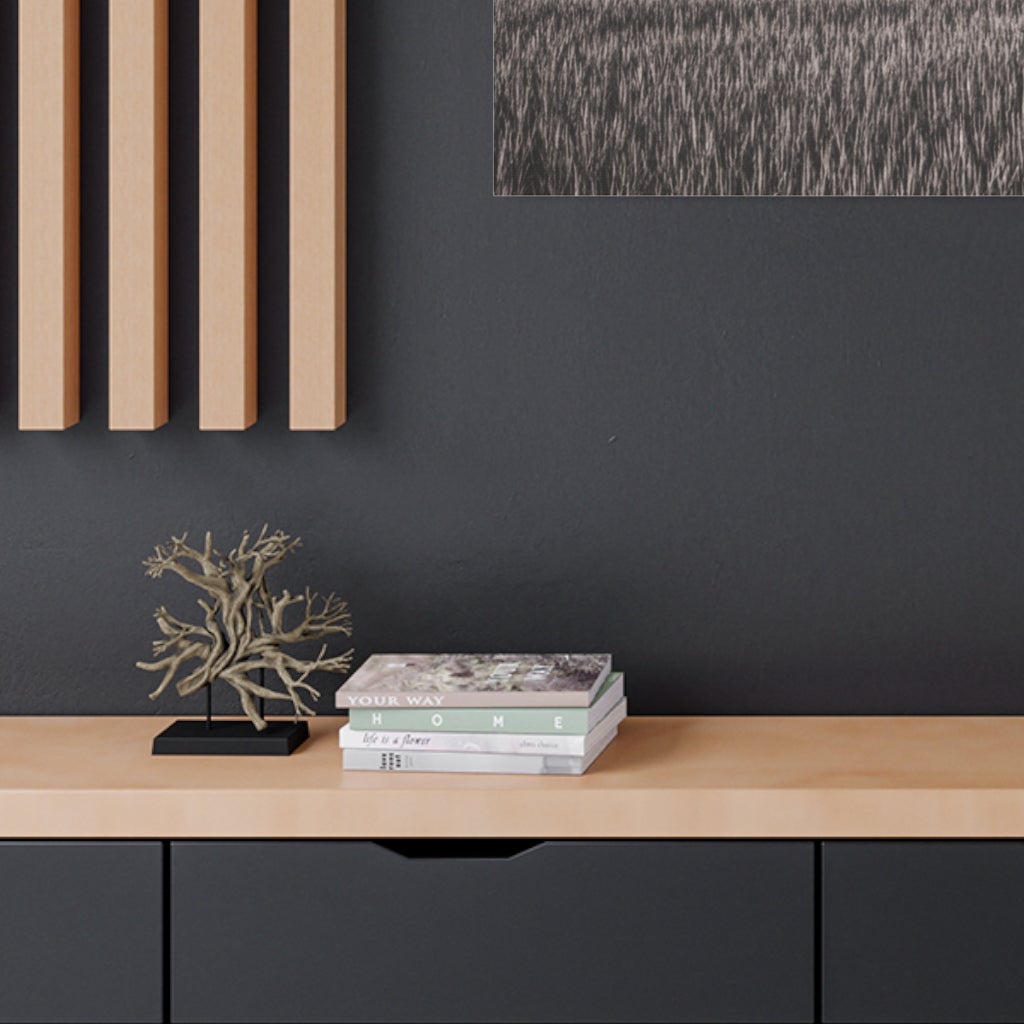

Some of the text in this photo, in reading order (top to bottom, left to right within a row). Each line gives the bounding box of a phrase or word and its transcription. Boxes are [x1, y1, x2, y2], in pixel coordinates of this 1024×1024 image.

[348, 696, 444, 706] YOUR WAY
[363, 732, 378, 746] life
[400, 733, 432, 748] flower
